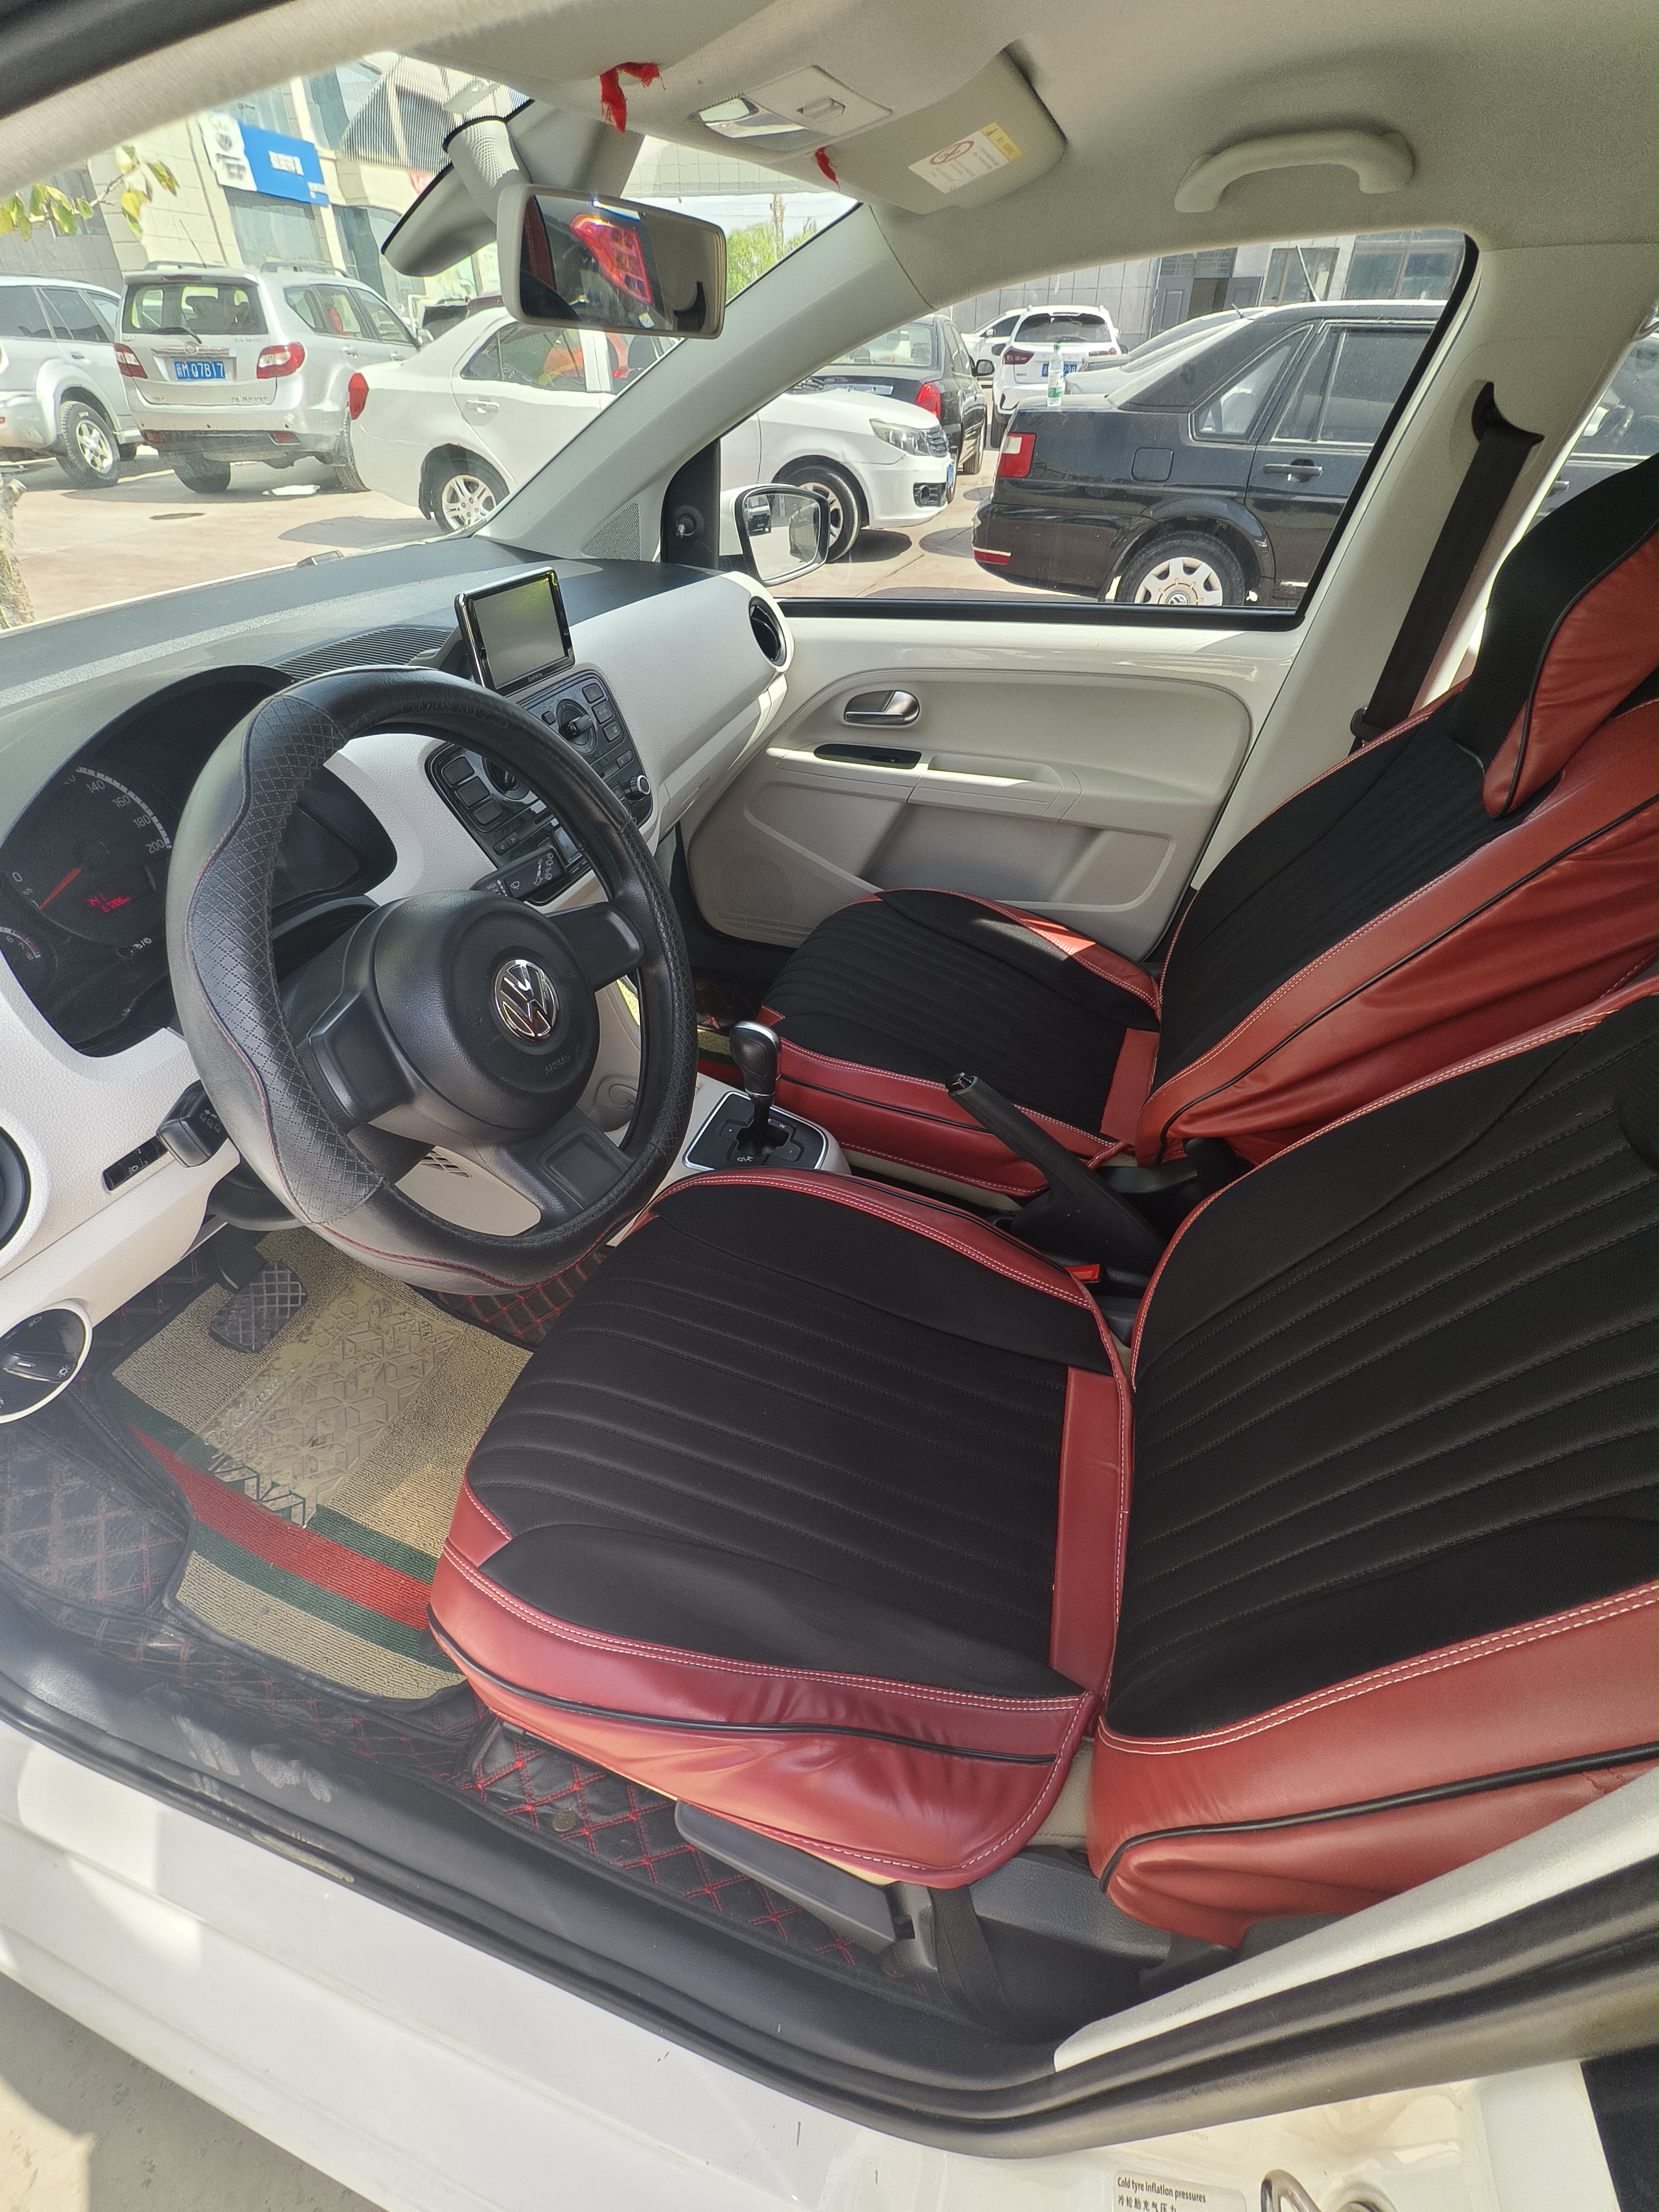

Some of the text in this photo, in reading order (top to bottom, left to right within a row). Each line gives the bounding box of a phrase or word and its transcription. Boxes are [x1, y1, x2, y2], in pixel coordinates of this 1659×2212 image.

[86, 780, 106, 794] 140
[112, 794, 131, 808] 160
[133, 814, 151, 828] 180
[145, 839, 165, 853] 200
[12, 872, 23, 882] 0
[6, 935, 14, 943] 6
[18, 942, 24, 950] 7
[1117, 2176, 1206, 2203] Cold tyre inflation pressures
